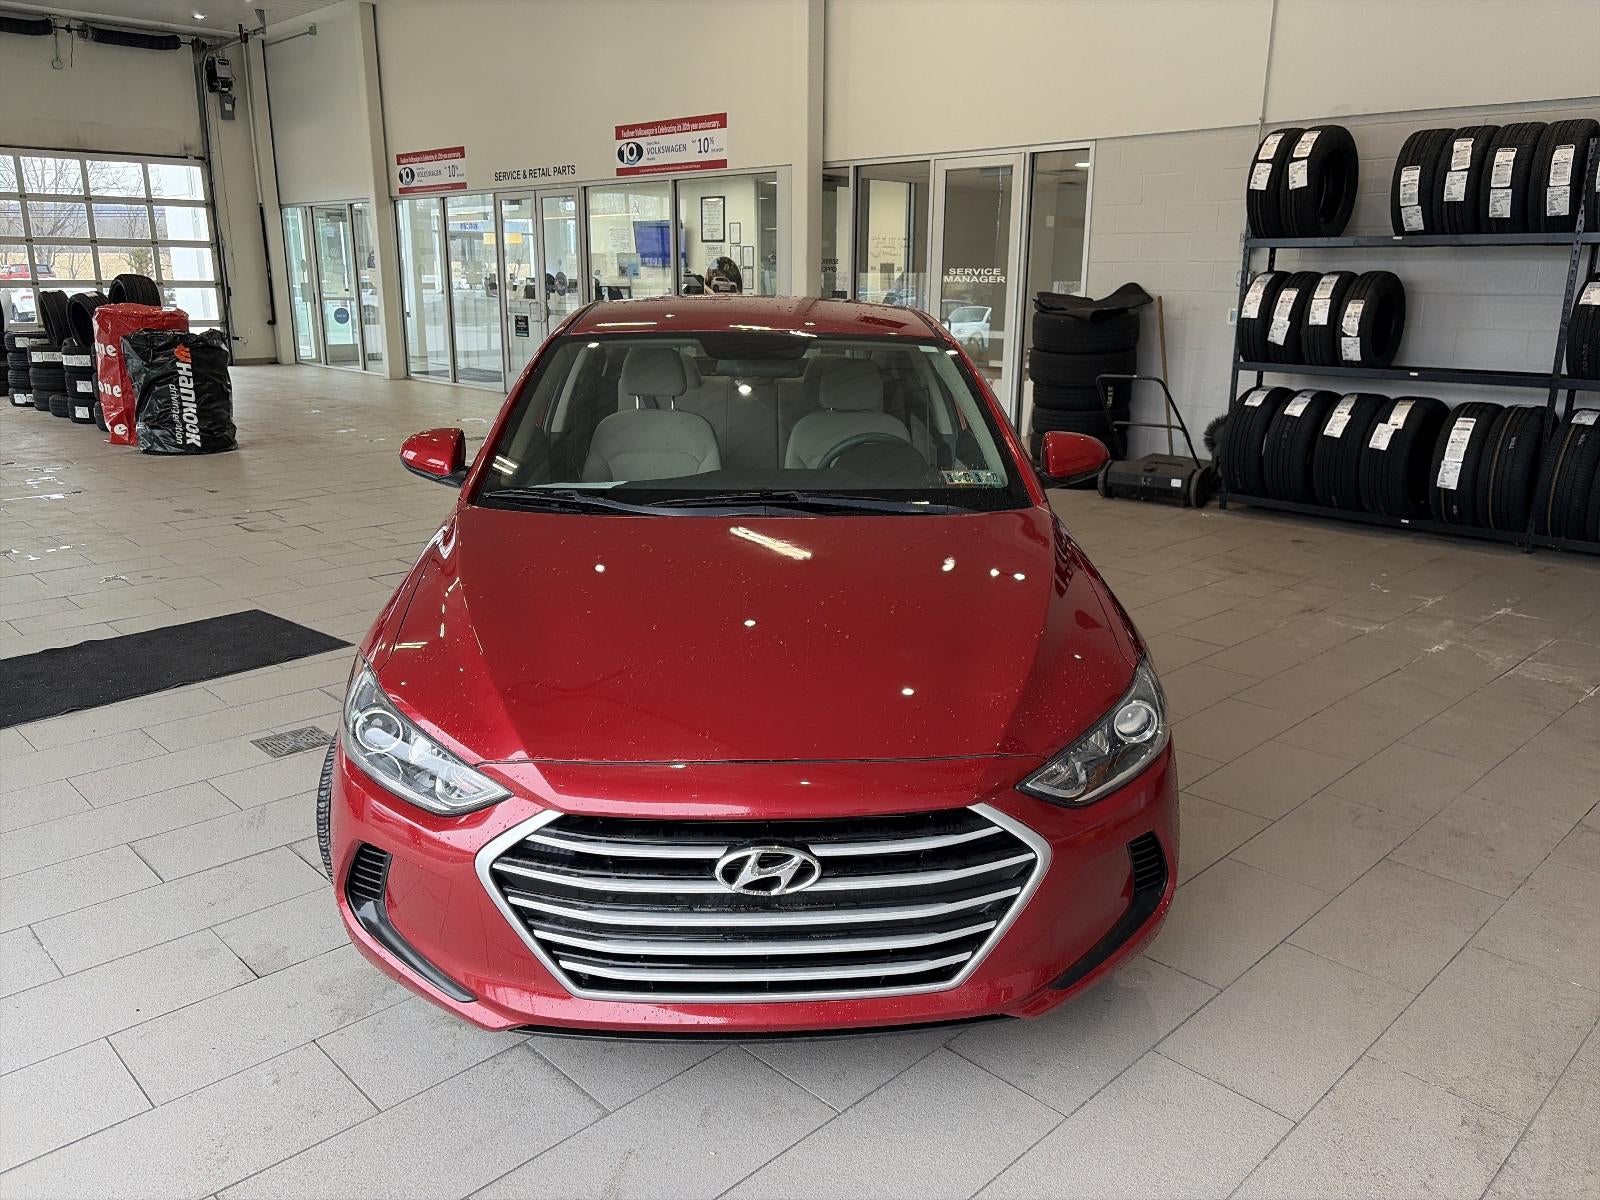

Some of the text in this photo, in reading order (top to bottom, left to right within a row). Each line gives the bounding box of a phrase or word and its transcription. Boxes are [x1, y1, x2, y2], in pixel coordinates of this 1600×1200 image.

[657, 124, 677, 135] Celebrating
[646, 143, 687, 156] VOLKSWAGEN
[494, 164, 576, 182] SERVICE & RETAIL PARTS
[948, 267, 1001, 276] SERVICE
[943, 275, 1006, 284] MANAGER
[176, 361, 202, 448] Hankook
